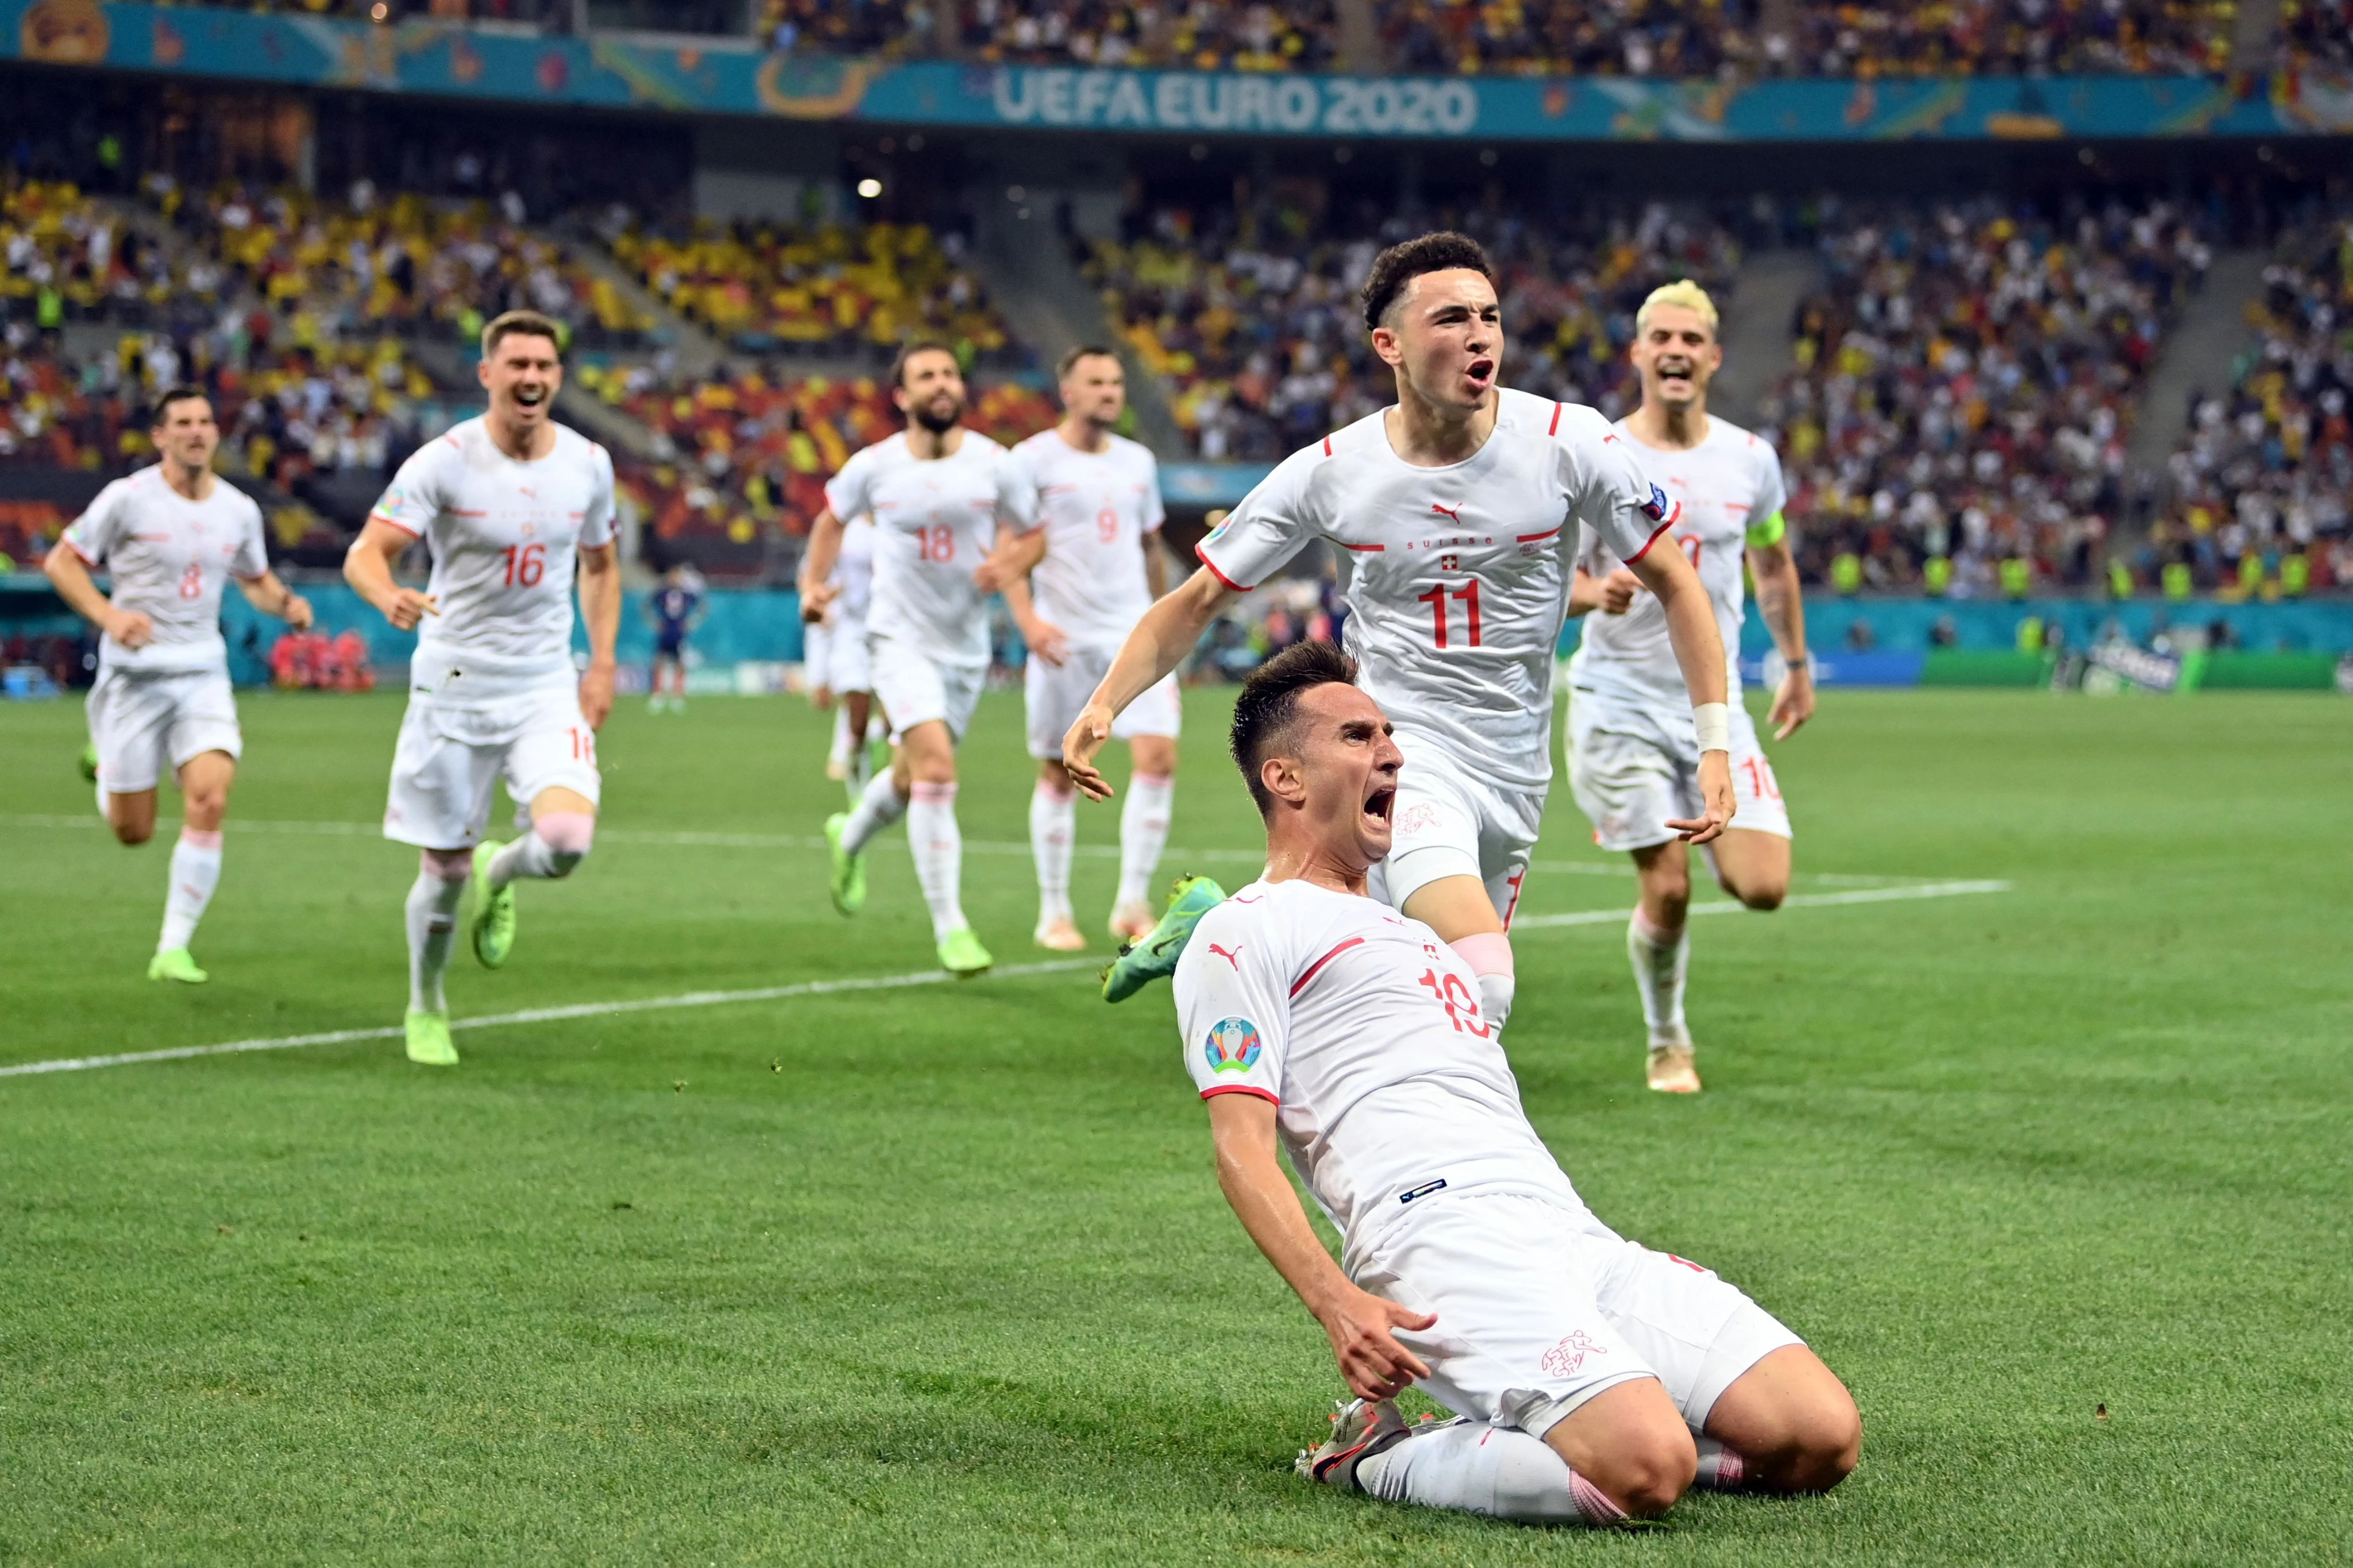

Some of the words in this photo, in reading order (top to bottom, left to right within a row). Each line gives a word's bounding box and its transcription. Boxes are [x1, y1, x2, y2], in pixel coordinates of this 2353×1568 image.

[993, 68, 1148, 124] UEFA
[1155, 72, 1318, 130] EURO
[1326, 78, 1477, 134] 2020
[917, 525, 955, 564] 18
[1096, 508, 1119, 545] 9
[180, 563, 201, 601] 8
[499, 543, 546, 587] 16
[1418, 579, 1480, 648] 11
